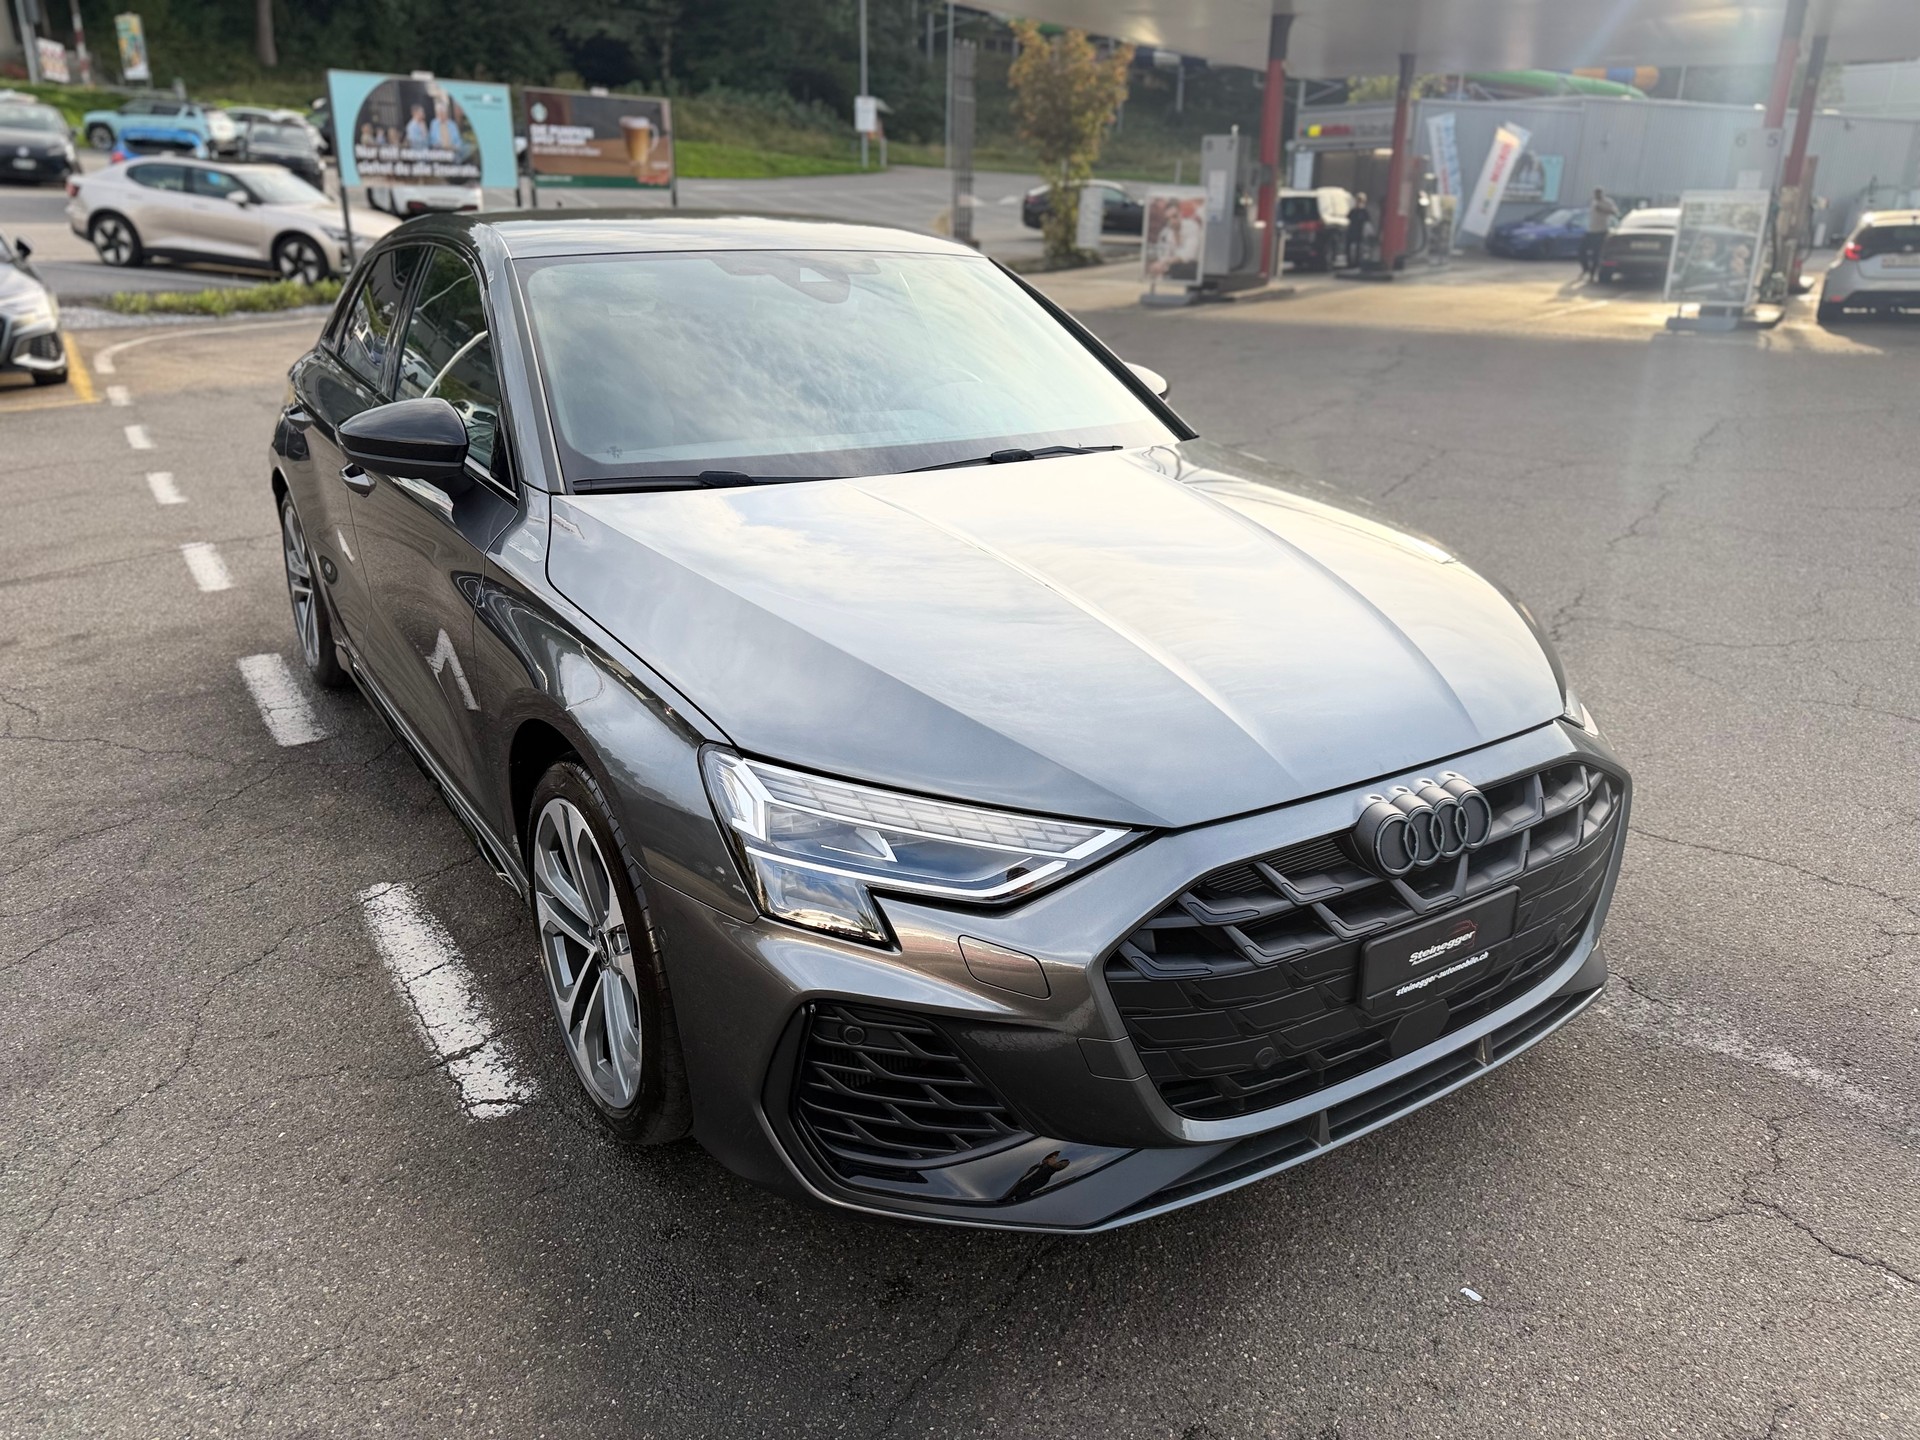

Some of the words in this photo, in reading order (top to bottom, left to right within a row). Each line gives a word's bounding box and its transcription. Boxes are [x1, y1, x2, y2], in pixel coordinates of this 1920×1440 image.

[355, 144, 378, 159] Nur
[1408, 930, 1476, 962] Steinegger
[1395, 950, 1489, 996] steinegger-automobile.ch
